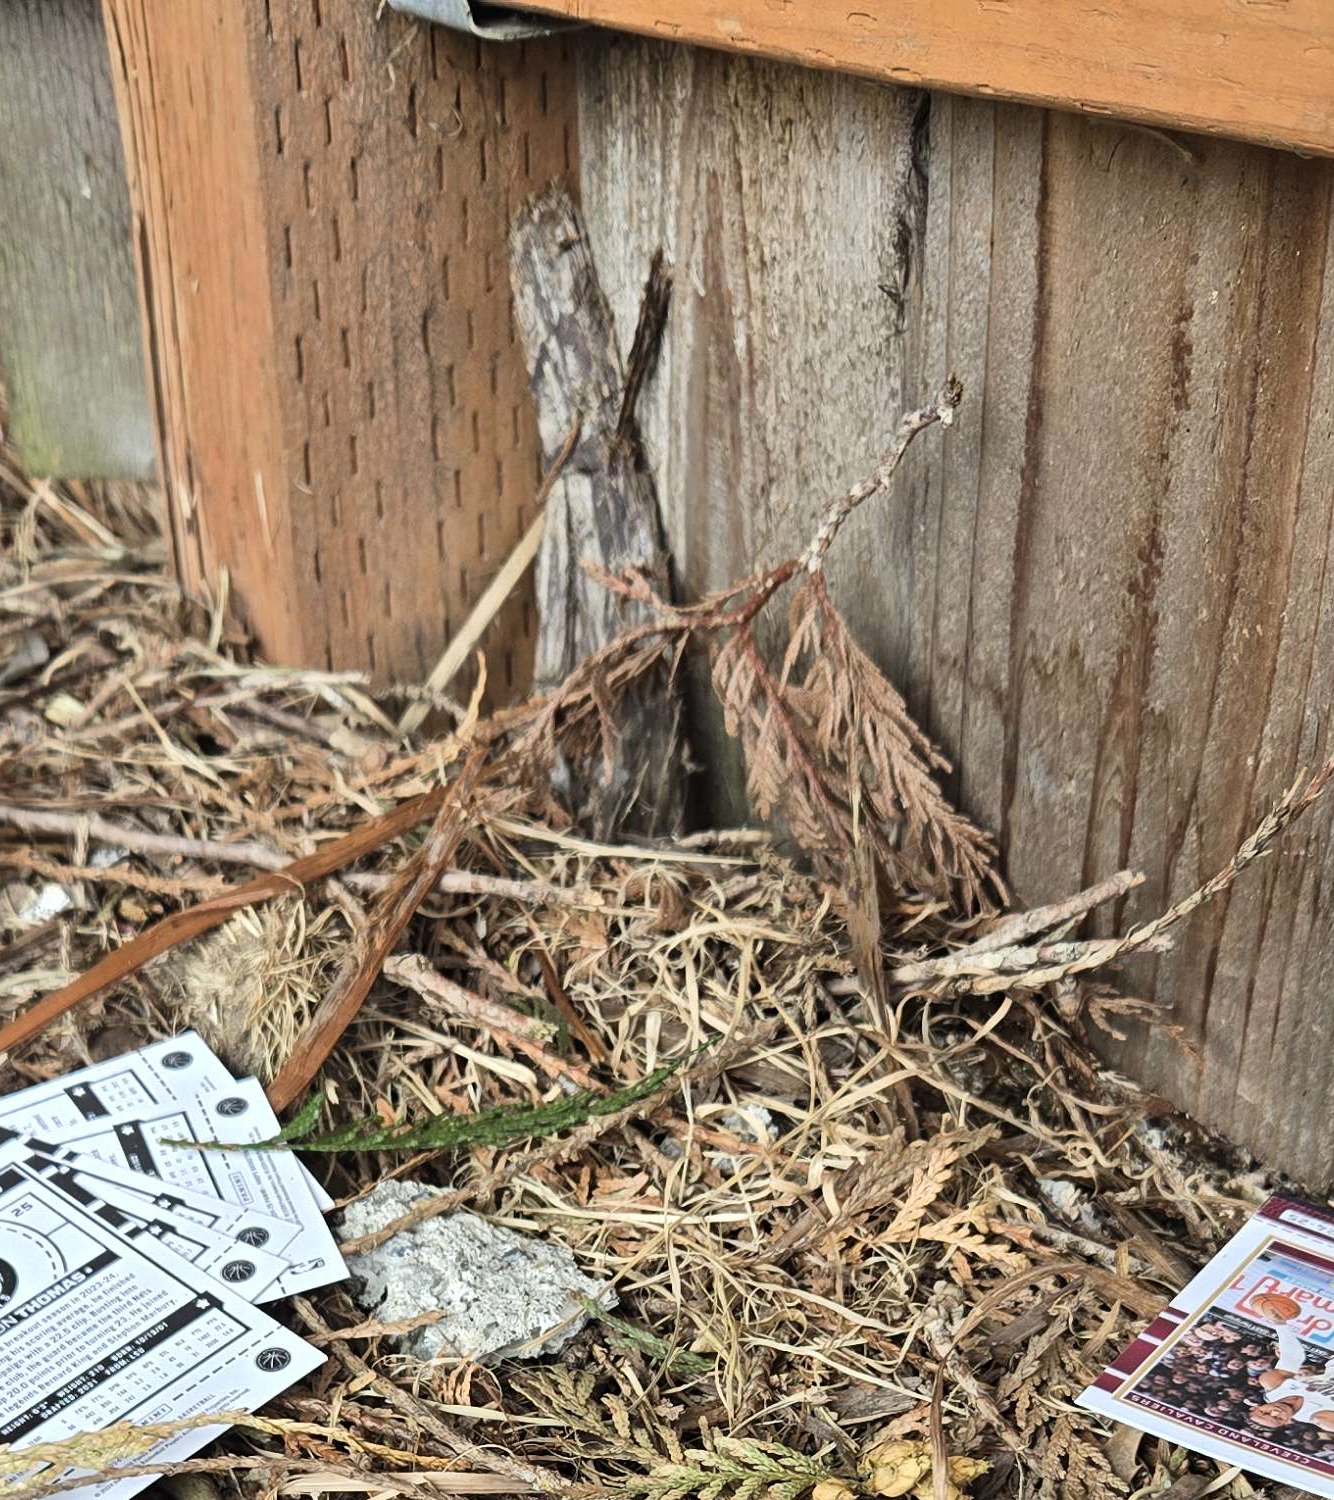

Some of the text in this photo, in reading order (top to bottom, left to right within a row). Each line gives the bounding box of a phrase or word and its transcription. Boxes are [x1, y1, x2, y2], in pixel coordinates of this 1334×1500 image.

[8, 1200, 36, 1218] 25
[9, 1343, 27, 1356] his
[89, 1292, 106, 1304] he
[100, 1271, 138, 1296] finished
[12, 1269, 89, 1320] THOMAS
[22, 1344, 46, 1360] with
[118, 1282, 141, 1297] into
[2, 1388, 42, 1415] legends
[36, 1365, 75, 1391] Bernard
[69, 1352, 95, 1369] King
[89, 1341, 110, 1356] and
[105, 1319, 145, 1346] Stephon
[25, 1359, 44, 1372] the
[39, 1343, 70, 1363] guard
[63, 1322, 101, 1346] became
[96, 1312, 115, 1325] the
[109, 1298, 136, 1316] third
[26, 1364, 59, 1386] points
[53, 1349, 80, 1368] prior
[73, 1343, 88, 1353] to
[83, 1323, 119, 1347] turning
[127, 1305, 145, 1318] He
[139, 1288, 172, 1310] joined
[1129, 1392, 1311, 1464] CLEVELAND CAVALIERS
